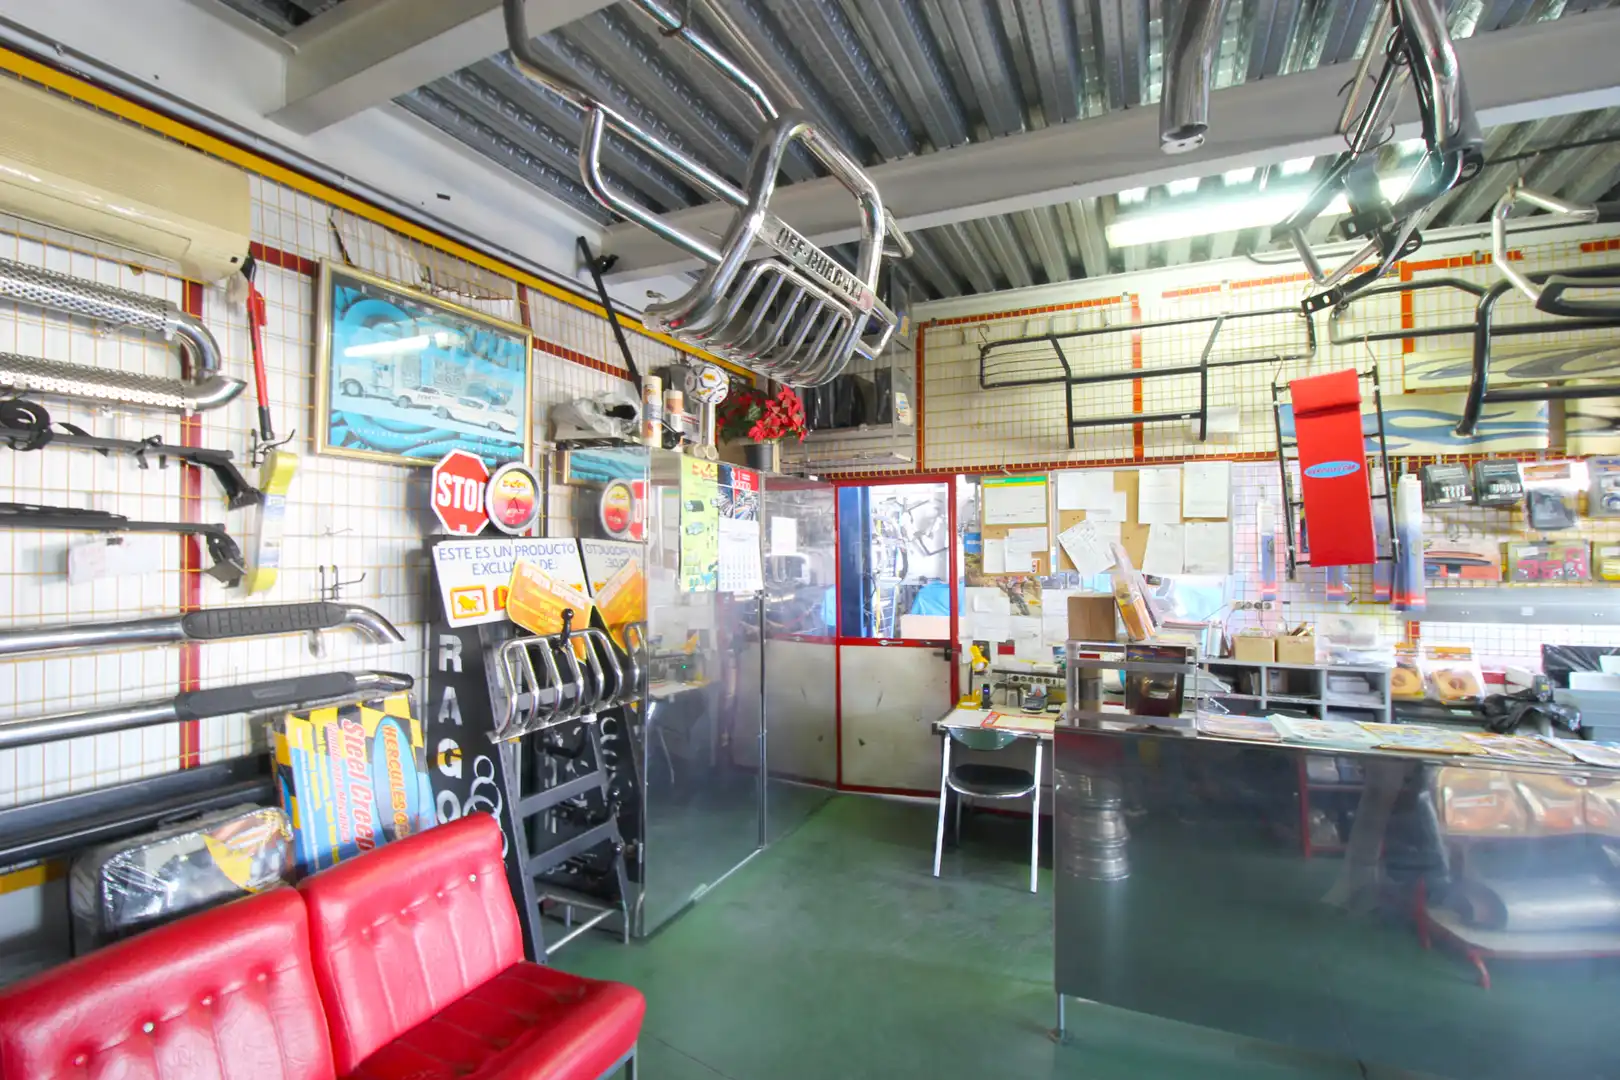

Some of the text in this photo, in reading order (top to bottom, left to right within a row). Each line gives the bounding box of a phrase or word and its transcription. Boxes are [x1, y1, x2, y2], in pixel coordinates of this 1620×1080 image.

[438, 542, 576, 561] ESTE ES UN PRODUCTO
[341, 718, 370, 784] Steel
[382, 725, 407, 812] HERCULES
